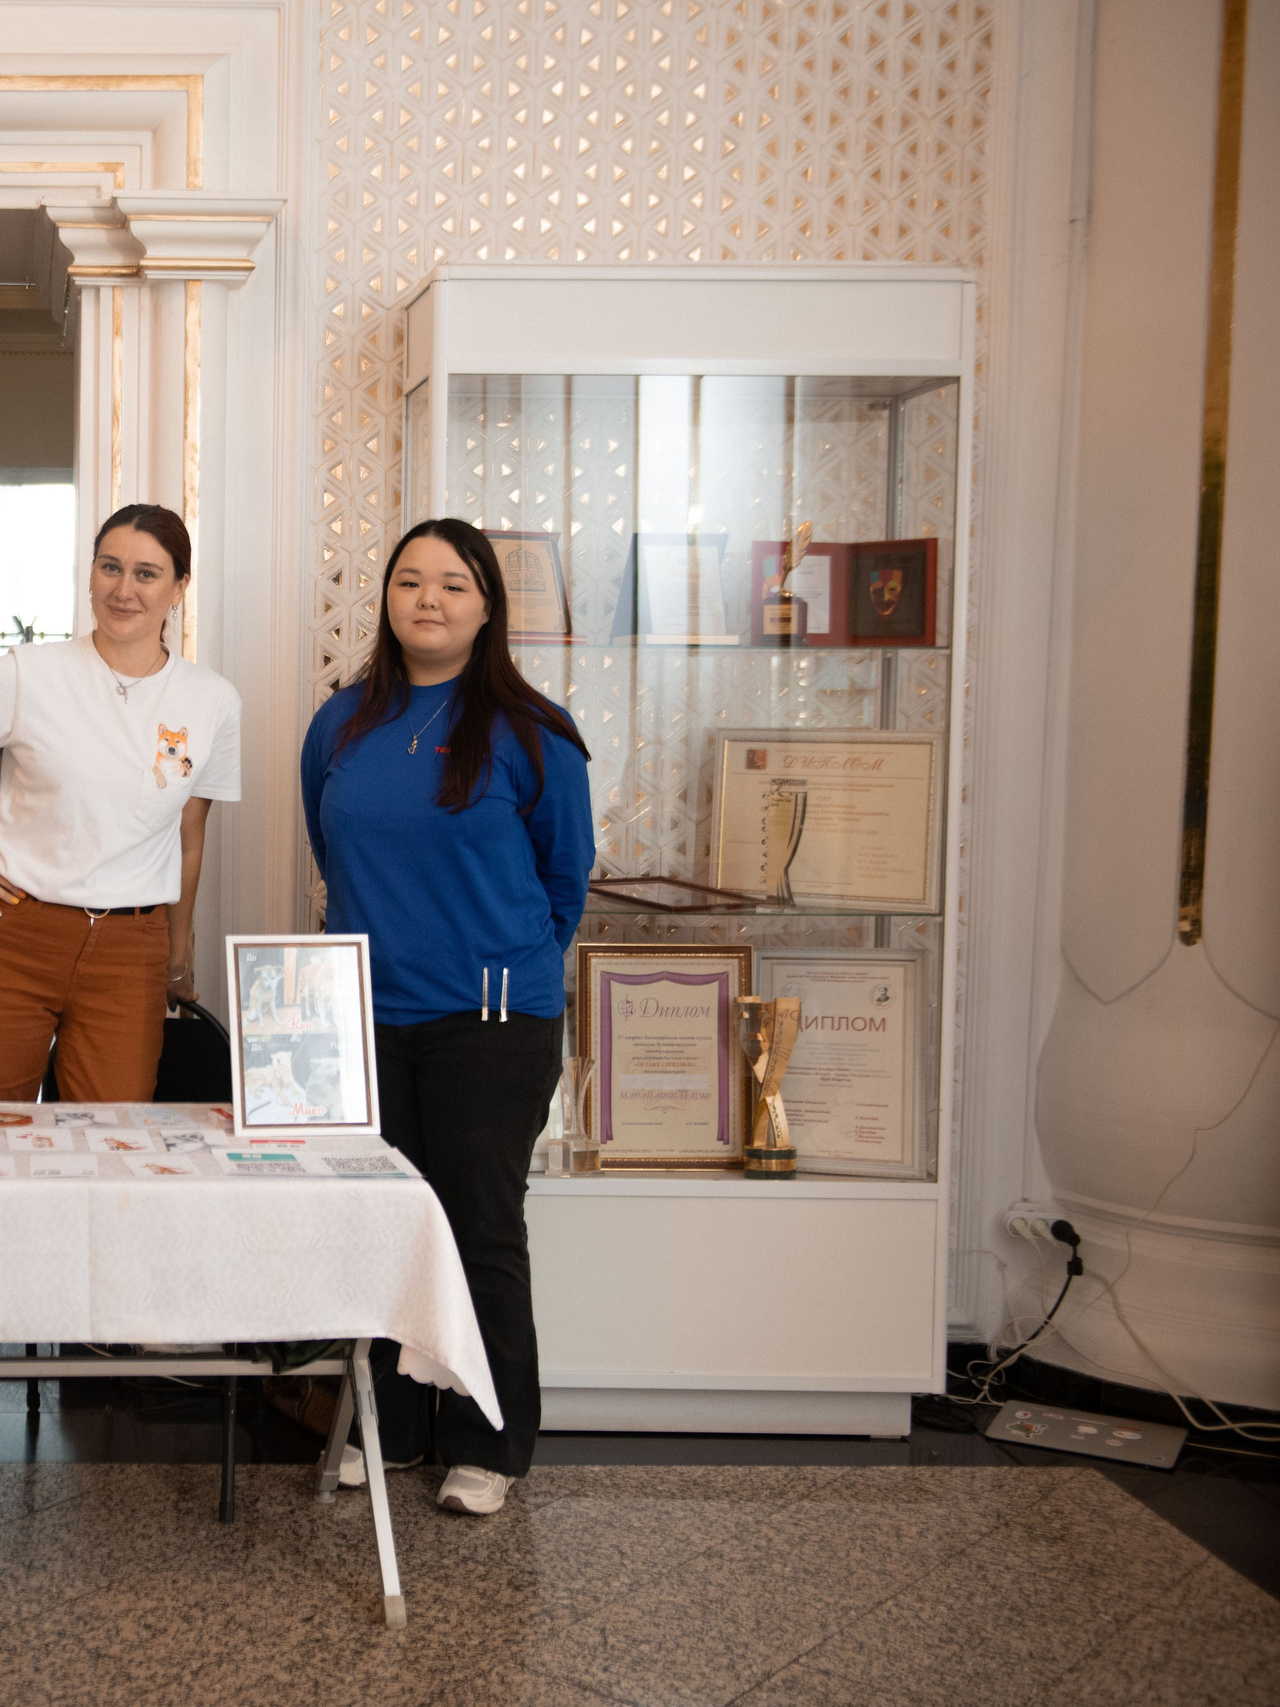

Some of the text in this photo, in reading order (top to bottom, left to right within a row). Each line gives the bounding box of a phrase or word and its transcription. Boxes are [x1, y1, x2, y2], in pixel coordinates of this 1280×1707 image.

[639, 997, 711, 1019] Диплом
[286, 1016, 314, 1031] Кен
[289, 1102, 325, 1117] Мико
